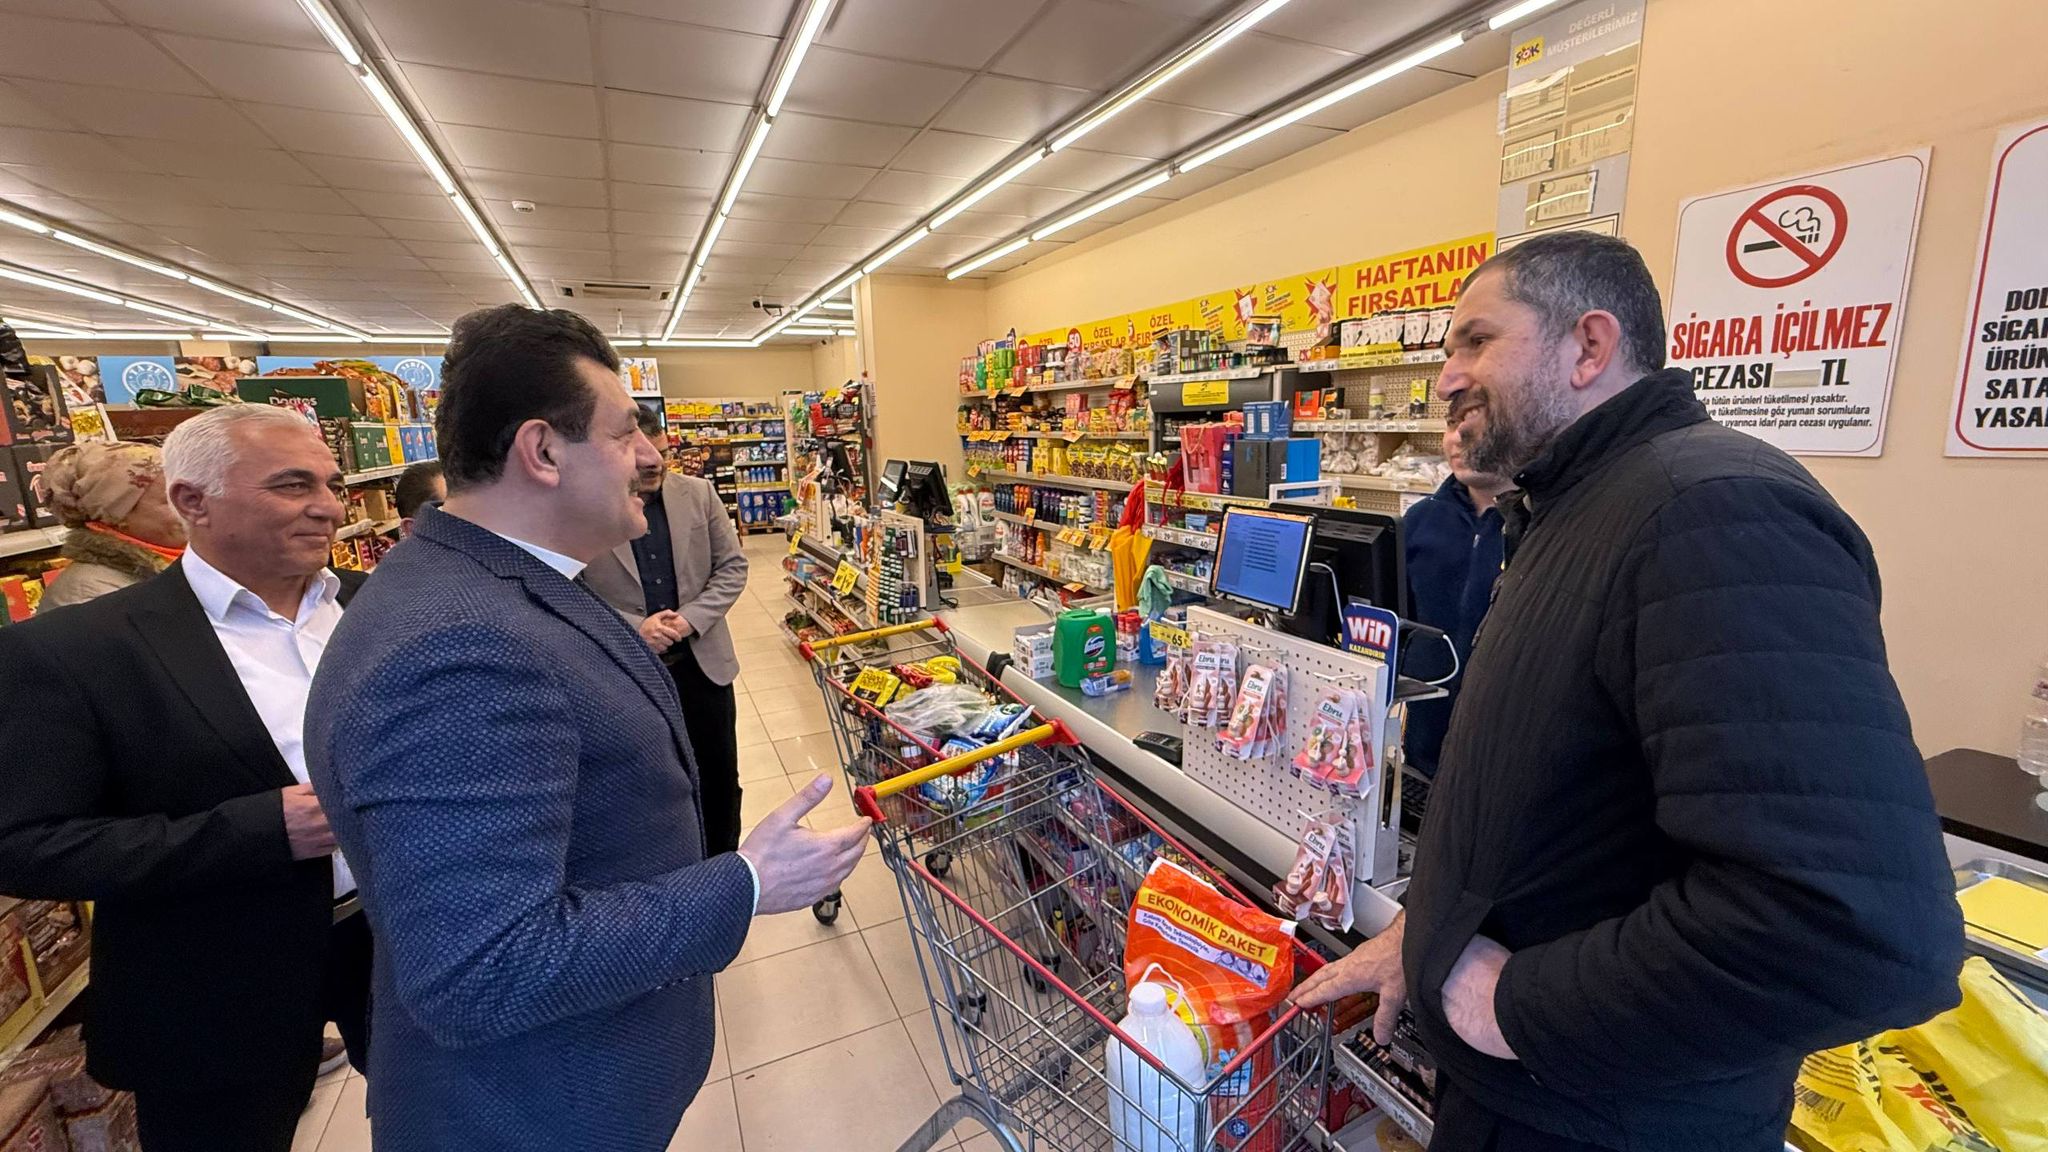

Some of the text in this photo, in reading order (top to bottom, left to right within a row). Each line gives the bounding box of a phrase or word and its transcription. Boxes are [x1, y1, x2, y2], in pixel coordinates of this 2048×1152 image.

[1568, 3, 1615, 33] DEĞERLİ
[1547, 11, 1638, 56] MÜŞTERİLERİMİZ
[1356, 242, 1487, 290] HAFTANIN
[1149, 313, 1174, 328] ÖZEL
[1093, 326, 1114, 339] ÖZEL
[1671, 300, 1893, 360] SİGARA İÇİLMEZ
[129, 364, 163, 375] TAZE
[1693, 358, 1850, 390] CEZASI TL
[1711, 395, 1730, 405] tütün
[1732, 394, 1762, 405] ürünleri
[1763, 393, 1808, 404] tüketilmesi
[1810, 393, 1847, 406] yasaktır.
[1718, 406, 1768, 416] tüketilmesine
[1770, 406, 1786, 418] göz
[1787, 407, 1815, 418] yuman
[1817, 404, 1870, 415] sorumlulara
[1975, 406, 2048, 428] YASA
[1758, 417, 1777, 427] idari
[1778, 418, 1797, 428] para
[1798, 417, 1826, 427] cezası
[1828, 416, 1873, 429] uygulanır.
[1171, 633, 1183, 647] 65
[1347, 616, 1392, 650] Win
[1198, 654, 1215, 663] Ebru
[1246, 680, 1263, 692] Ebru
[1322, 702, 1343, 718] Ebru
[1309, 833, 1326, 851] Ebru
[1147, 893, 1218, 937] EKONOMİK
[1218, 929, 1267, 958] PAKET
